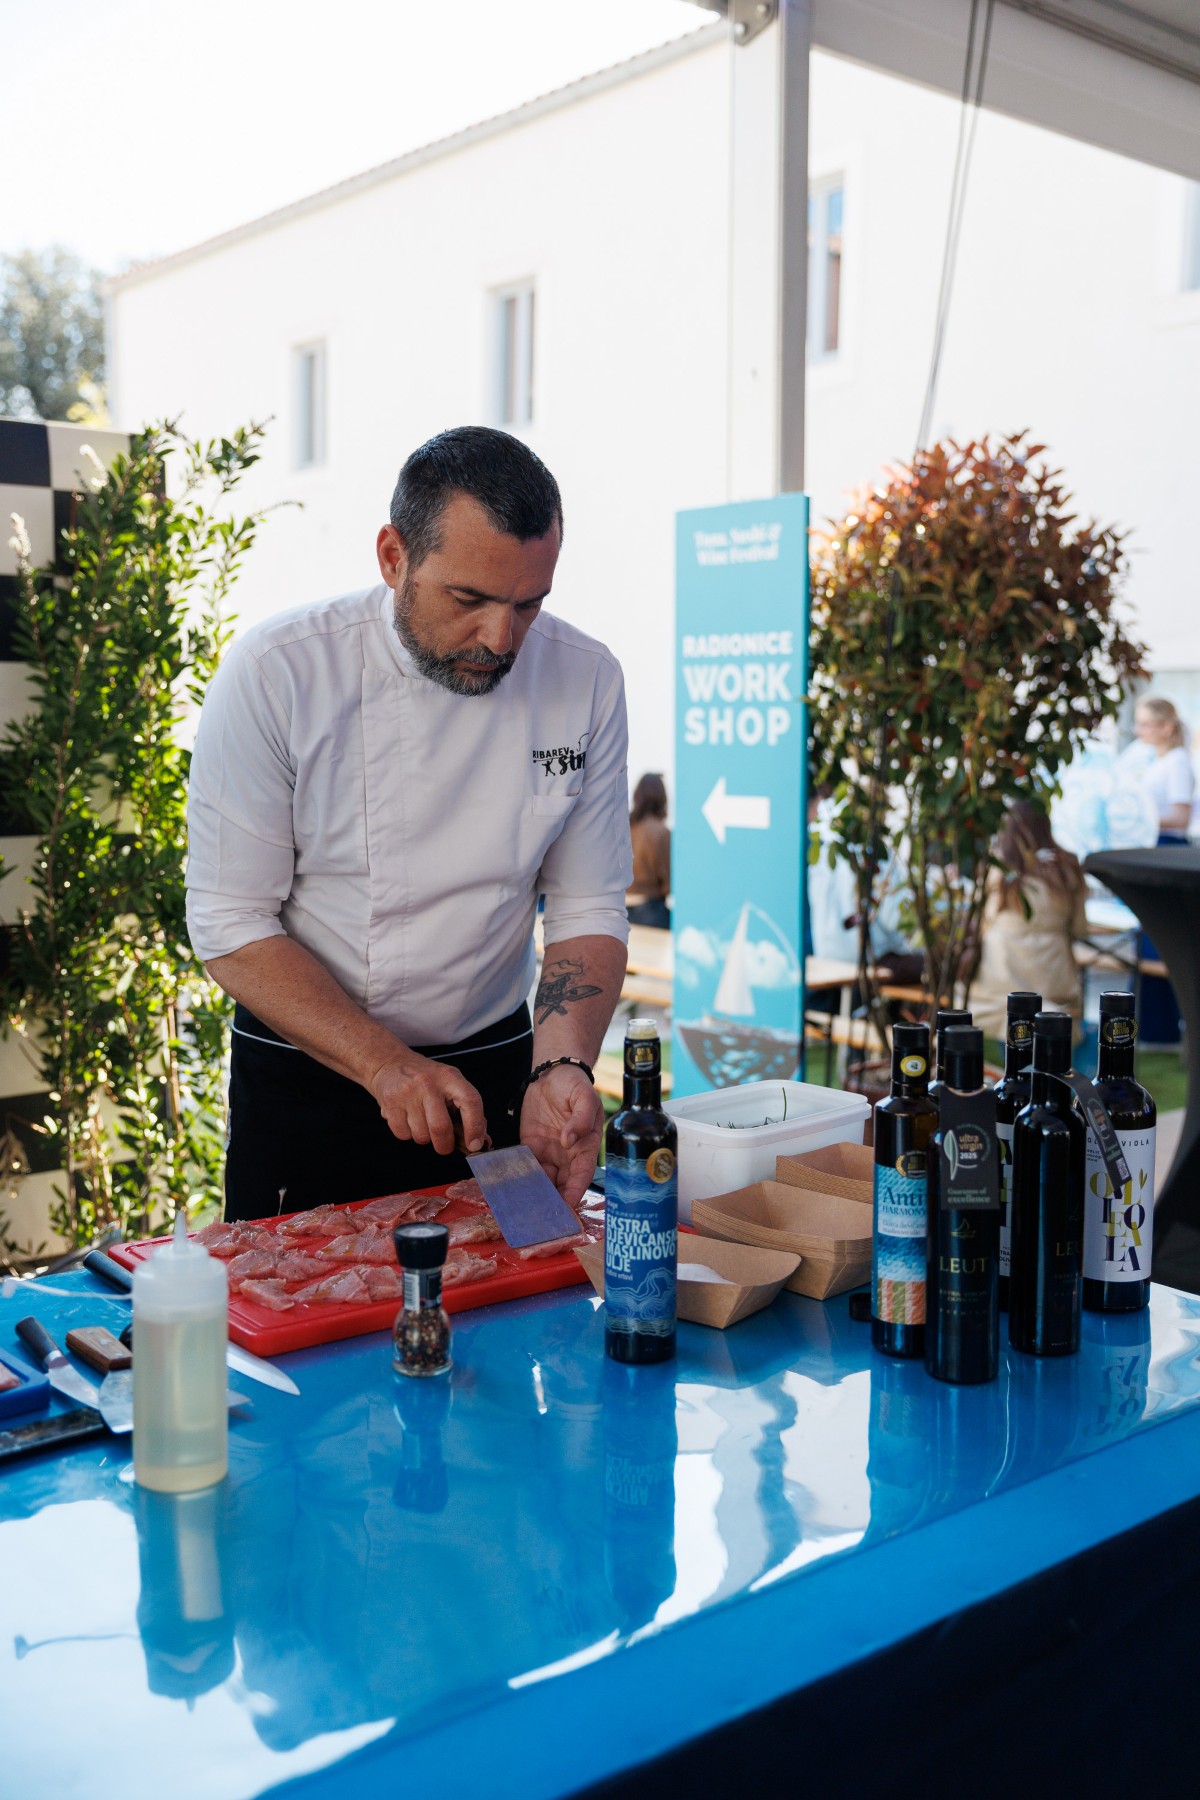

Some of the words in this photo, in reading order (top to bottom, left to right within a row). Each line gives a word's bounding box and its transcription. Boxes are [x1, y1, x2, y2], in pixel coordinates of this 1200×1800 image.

[683, 631, 793, 657] RADIONICE
[683, 662, 792, 703] WORK
[684, 706, 791, 746] SHOP
[532, 747, 570, 759] RIBAREV
[959, 1133, 980, 1142] ultra
[1121, 1139, 1150, 1147] VIOLA
[959, 1142, 983, 1152] virgin
[960, 1152, 978, 1160] 2025
[607, 1213, 650, 1234] EKSTRA
[606, 1241, 676, 1260] MASLINOVO
[606, 1253, 631, 1273] ULJE
[939, 1256, 988, 1274] LEUT
